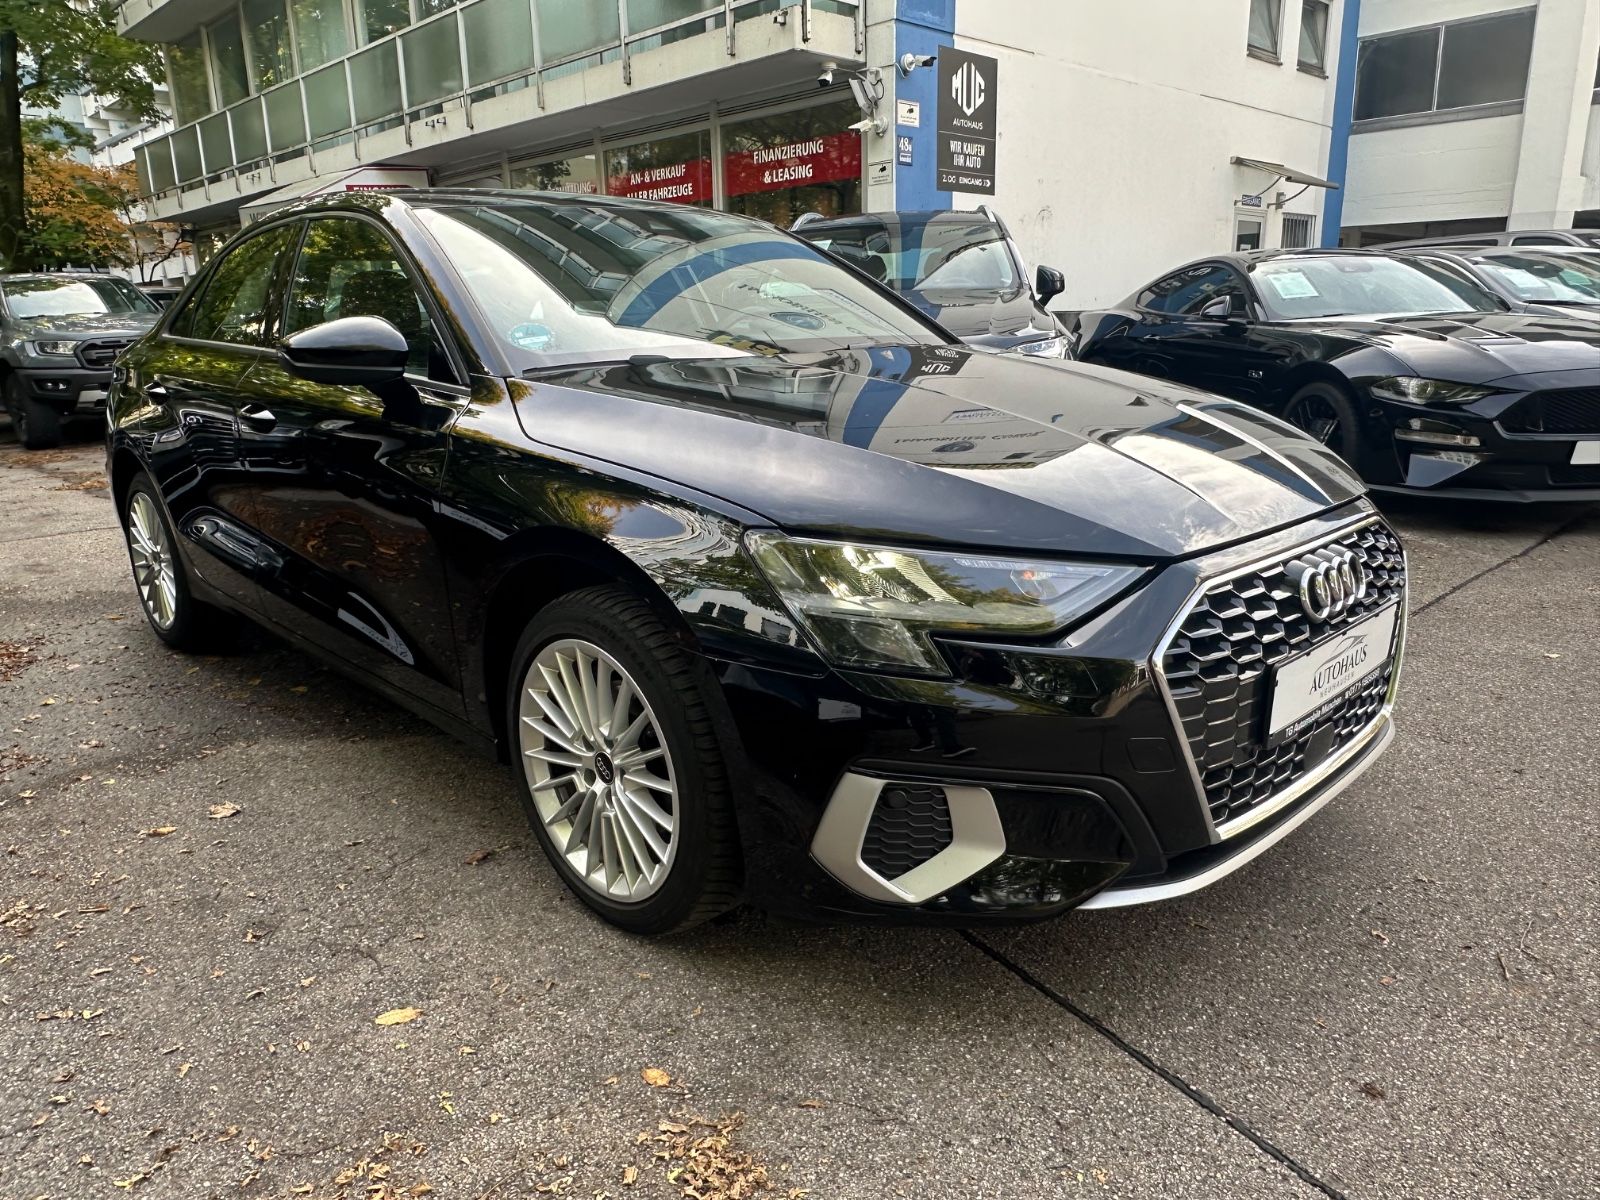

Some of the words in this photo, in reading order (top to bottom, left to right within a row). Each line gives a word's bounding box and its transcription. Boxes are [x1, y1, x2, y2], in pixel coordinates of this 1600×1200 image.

[952, 61, 985, 116] MUC
[952, 118, 984, 130] AUTOHAUS
[753, 139, 824, 164] FINANZIERUNG
[950, 140, 962, 153] WIR
[963, 141, 985, 156] KAUFEN
[953, 154, 965, 166] IHR
[965, 155, 981, 168] AUTO
[630, 173, 643, 185] AN-
[644, 169, 651, 183] &
[651, 164, 686, 181] VERKAUF
[764, 171, 772, 184] &
[773, 163, 813, 183] LEASING
[959, 176, 982, 187] EINGANG
[648, 182, 694, 200] FAHRZEUGE
[1309, 644, 1368, 695] AUTOHAUS
